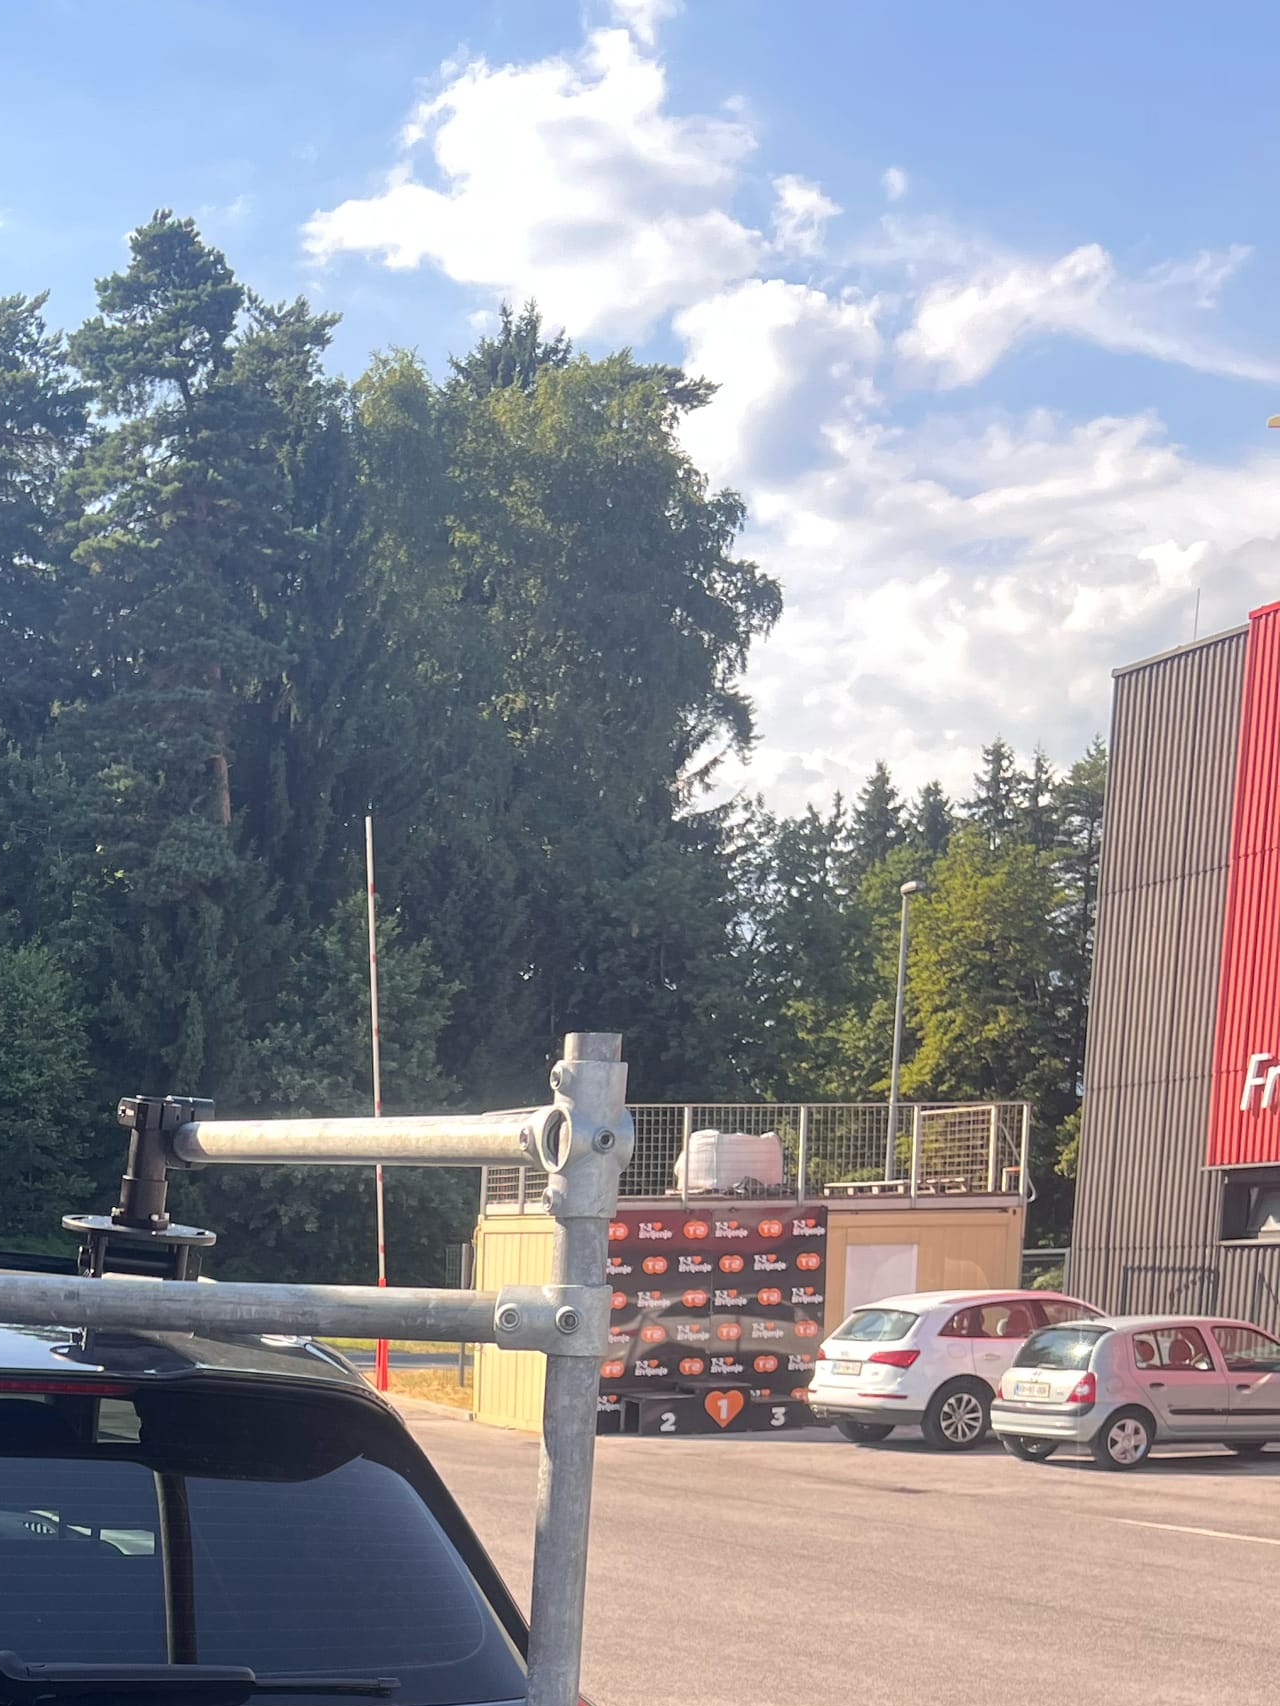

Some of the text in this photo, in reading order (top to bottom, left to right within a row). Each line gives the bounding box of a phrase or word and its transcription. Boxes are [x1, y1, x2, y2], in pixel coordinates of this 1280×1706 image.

[717, 1399, 728, 1420] 1
[770, 1406, 786, 1426] 3
[660, 1412, 676, 1432] 2
